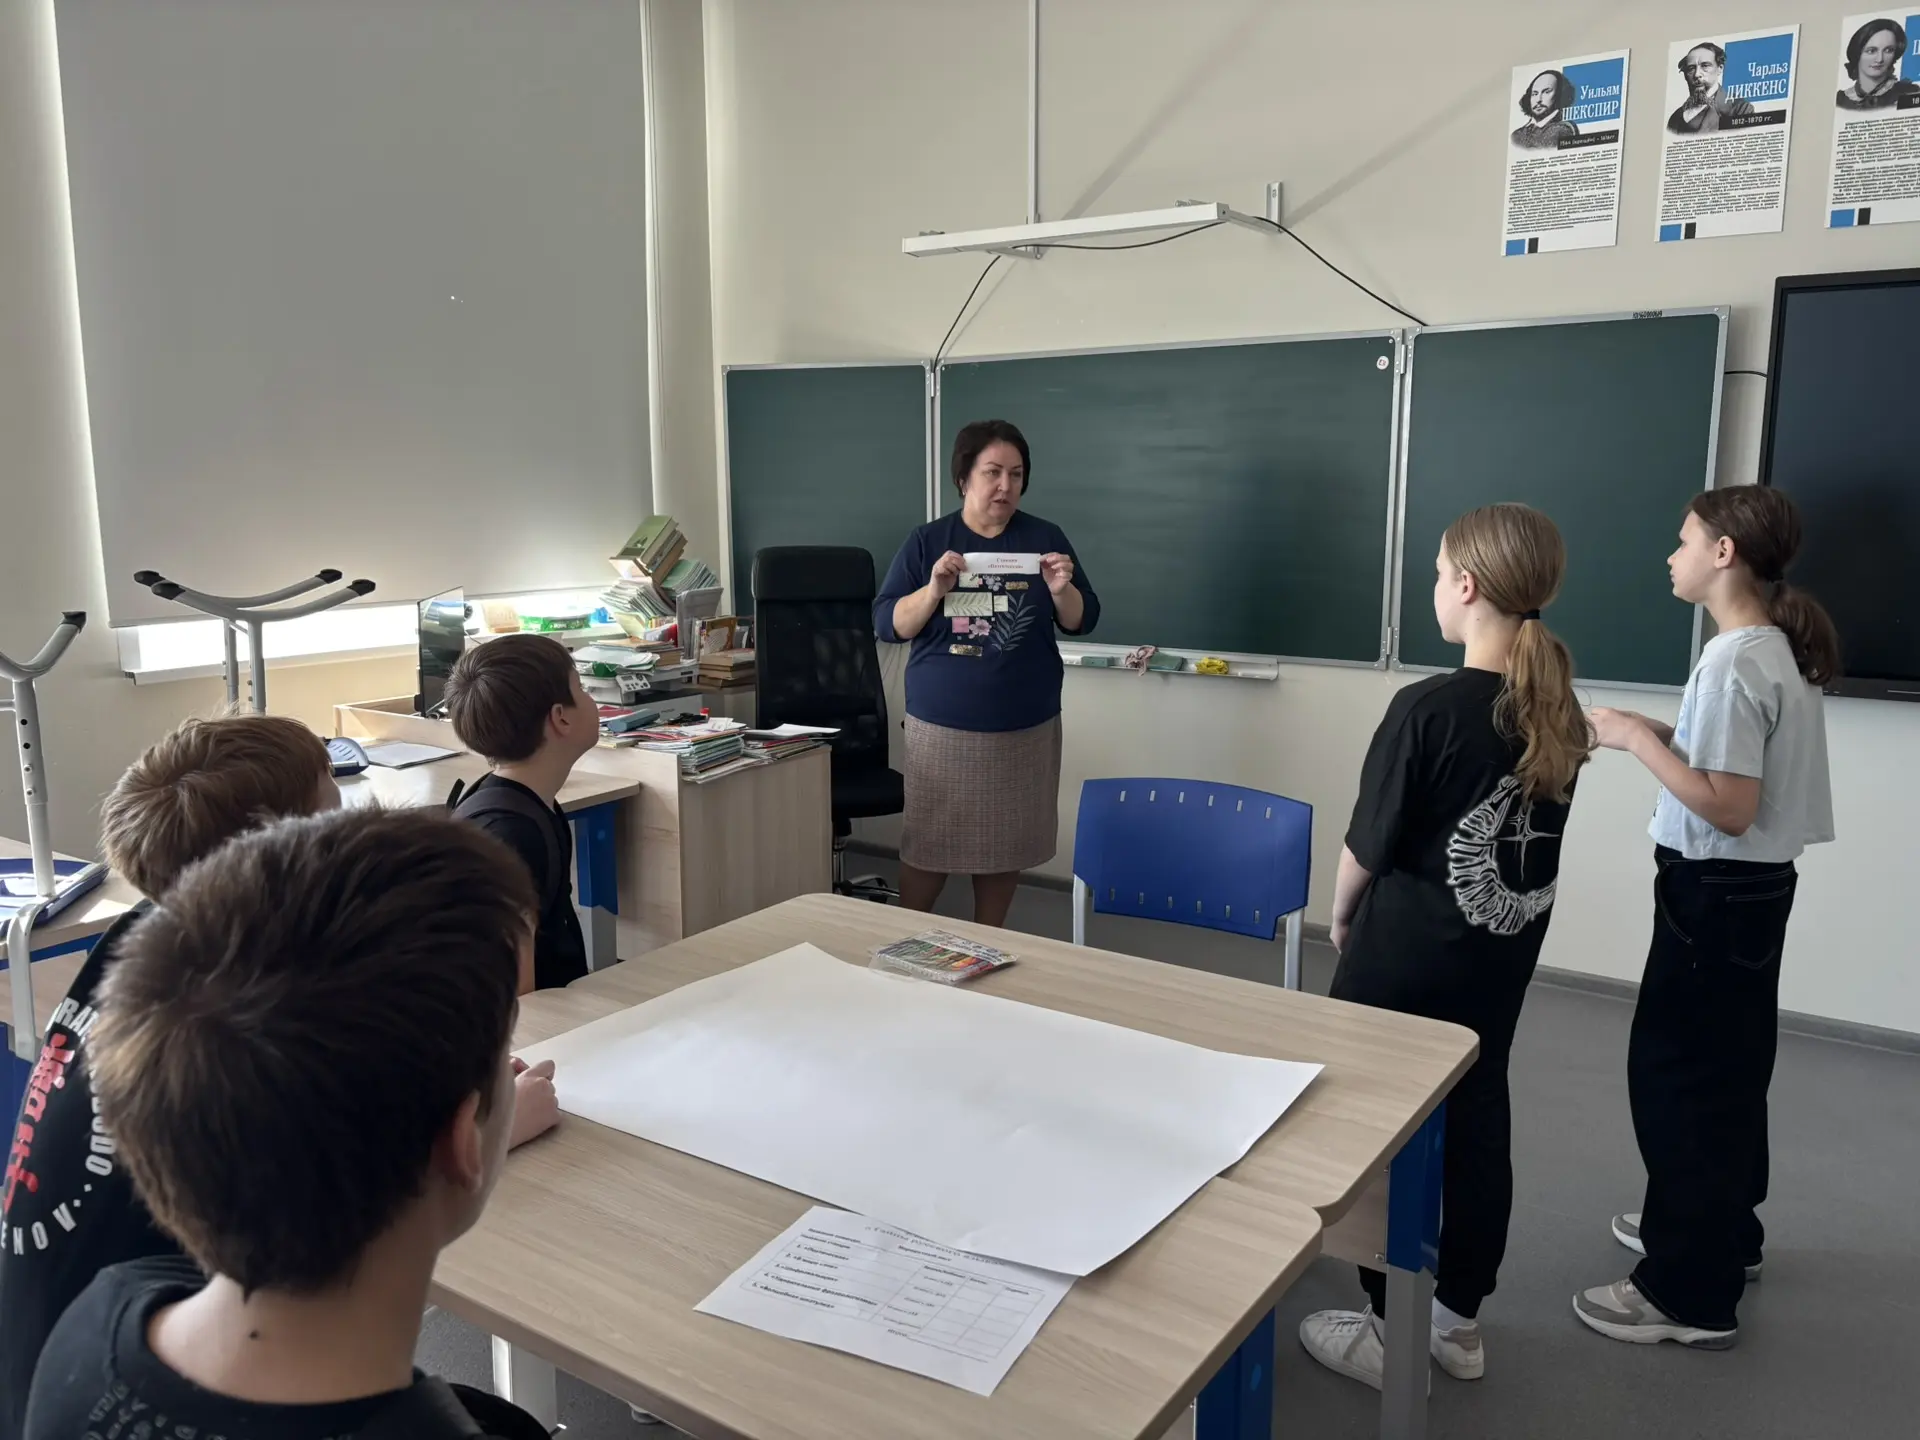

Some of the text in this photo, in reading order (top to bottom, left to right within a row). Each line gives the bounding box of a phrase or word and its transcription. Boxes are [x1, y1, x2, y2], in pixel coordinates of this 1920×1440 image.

[1748, 62, 1788, 79] Чарльз
[1580, 84, 1620, 100] Уильям
[1724, 78, 1787, 104] ДИККЕНС
[1562, 100, 1619, 121] ШЕКСПИР
[1731, 116, 1762, 125] 1812-1870
